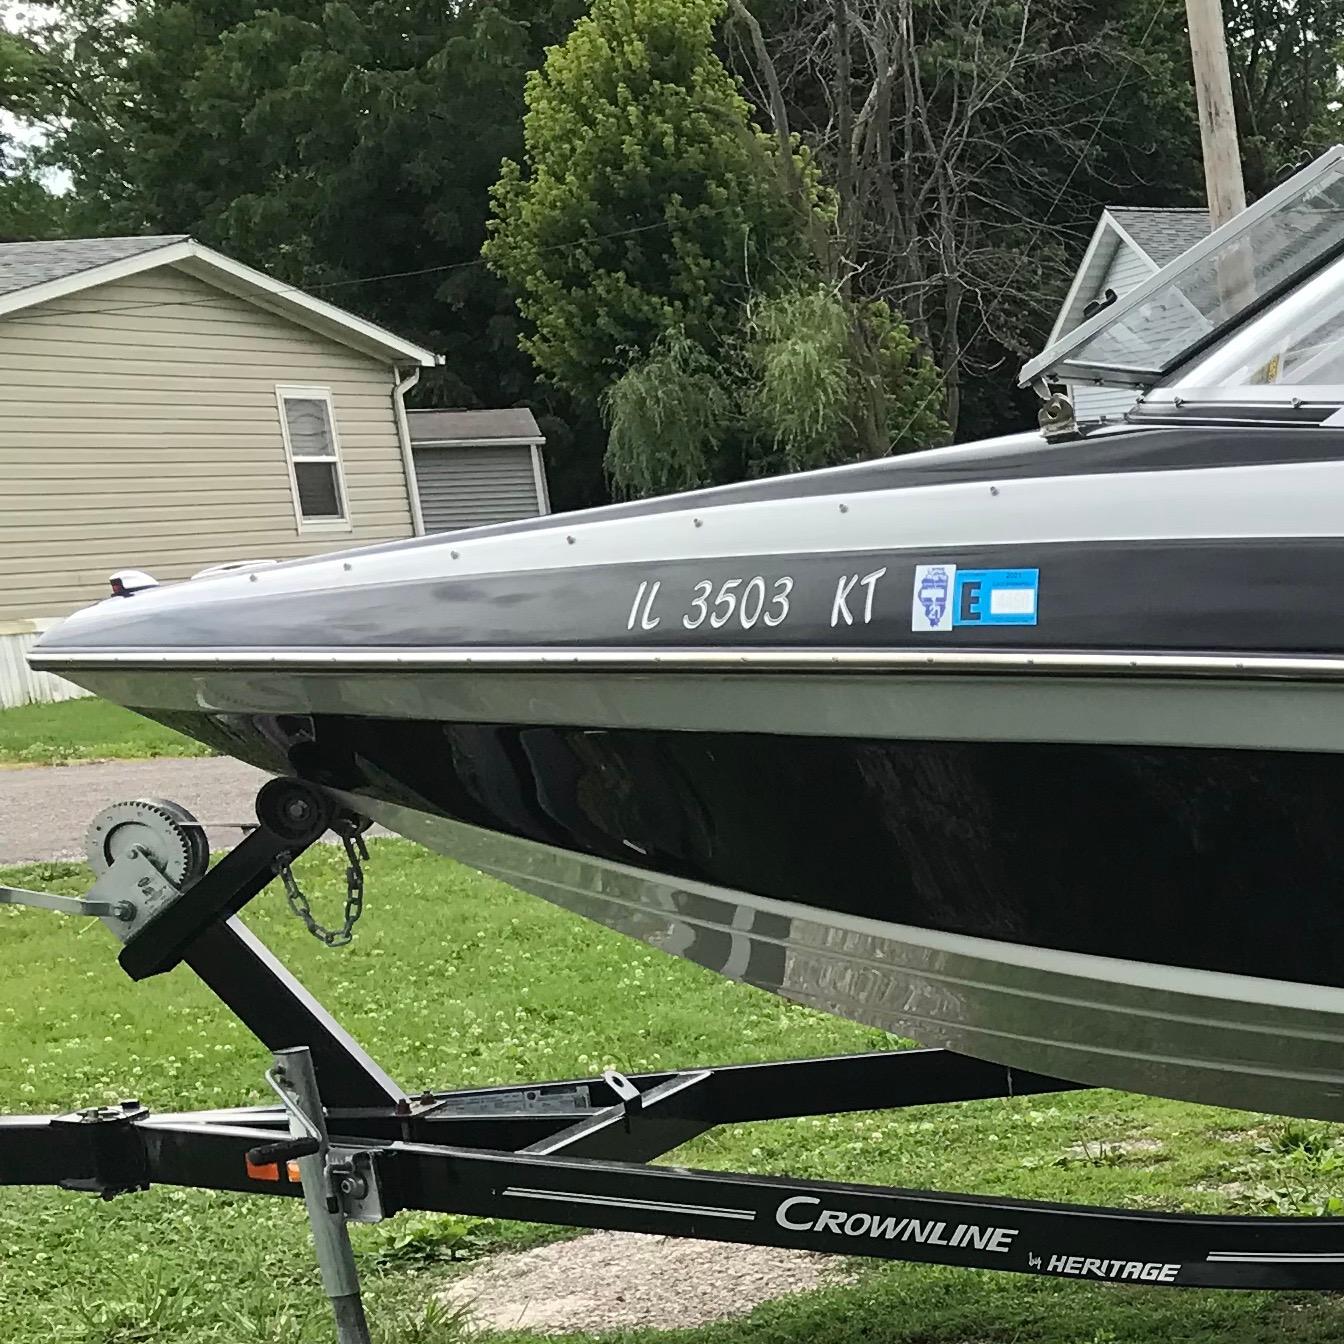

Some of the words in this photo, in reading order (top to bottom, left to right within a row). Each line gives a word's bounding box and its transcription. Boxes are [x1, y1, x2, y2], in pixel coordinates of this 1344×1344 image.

[627, 580, 661, 630] IL
[682, 576, 794, 630] 3503
[830, 567, 887, 628] KT
[960, 581, 982, 621] E
[775, 1196, 1019, 1253] CROWNLINE
[1028, 1251, 1042, 1271] by
[1046, 1254, 1182, 1283] HERITAGE
